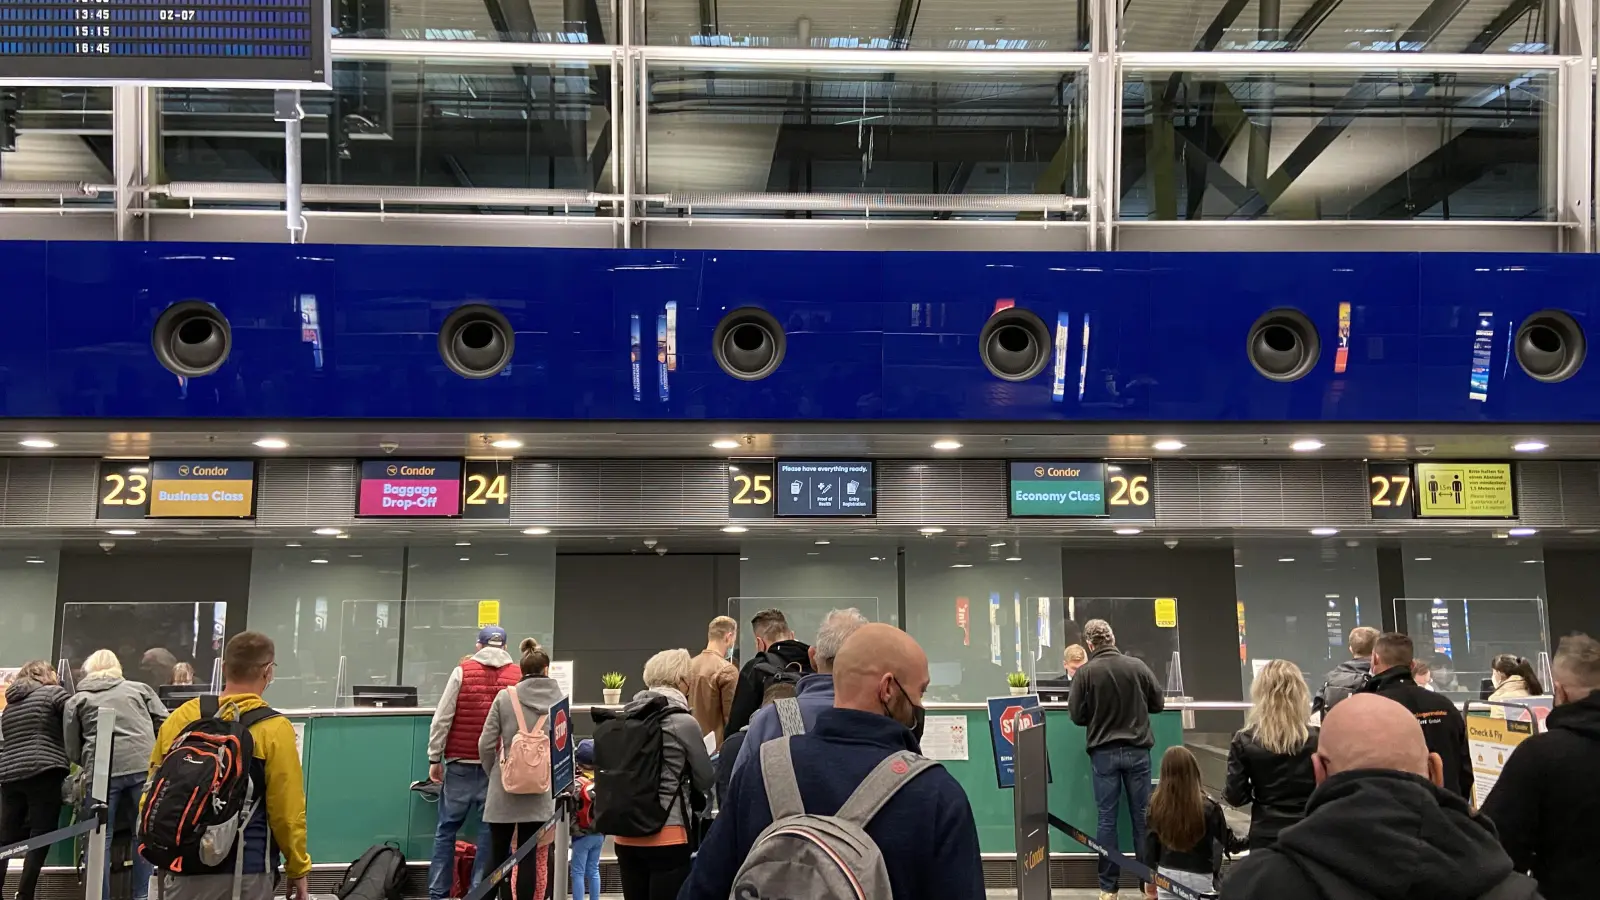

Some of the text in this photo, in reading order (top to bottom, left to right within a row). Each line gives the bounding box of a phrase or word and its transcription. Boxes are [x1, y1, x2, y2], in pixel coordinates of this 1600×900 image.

[75, 10, 195, 20] 13:45 02-07
[75, 26, 109, 36] 15:15
[192, 466, 228, 476] Condor
[400, 466, 436, 476] Condor
[1047, 467, 1080, 477] Condor
[103, 474, 147, 505] 23
[159, 490, 244, 501] Business Class
[383, 484, 437, 497] Baggage
[466, 474, 508, 505] 24
[732, 475, 772, 505] 25
[1110, 476, 1149, 505] 26
[1371, 476, 1411, 506] 27
[382, 497, 437, 510] Drop-Off
[1015, 490, 1101, 504] Economy Class
[1469, 726, 1503, 742] Check & Fly
[1029, 846, 1045, 870] Condor
